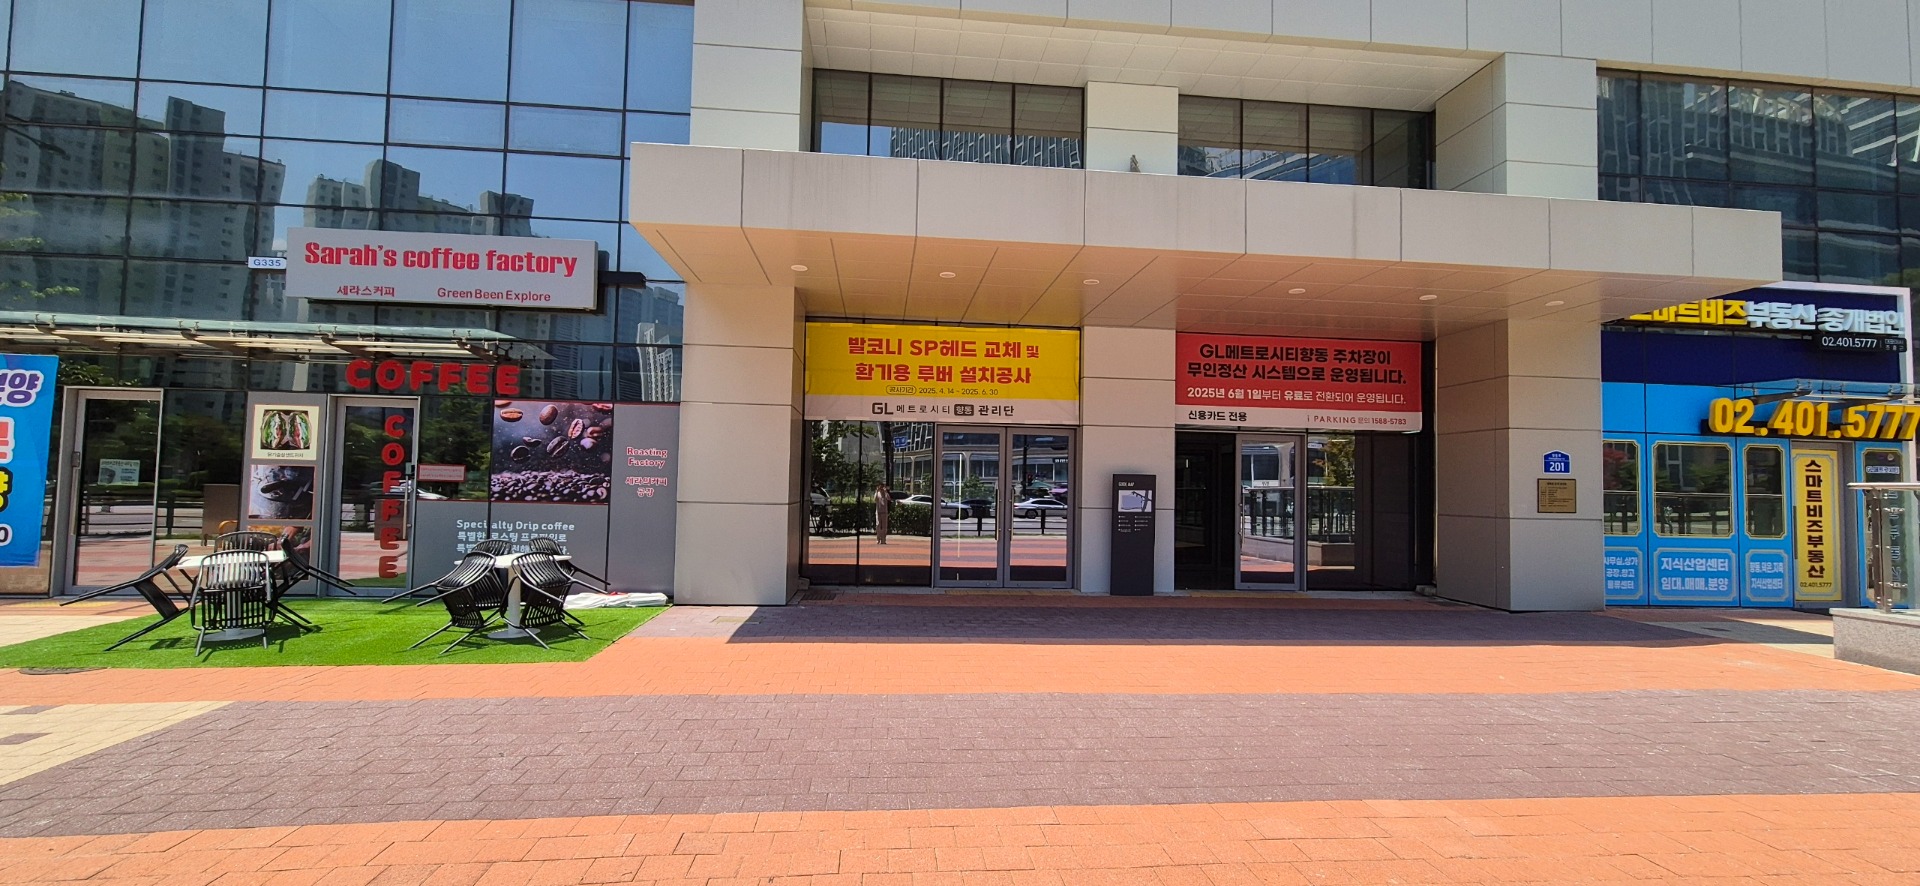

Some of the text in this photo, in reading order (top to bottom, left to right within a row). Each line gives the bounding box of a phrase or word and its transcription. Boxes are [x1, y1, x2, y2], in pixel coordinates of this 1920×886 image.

[253, 258, 282, 267] G335
[403, 247, 480, 271] coffee
[486, 250, 578, 278] factory
[337, 285, 395, 297] 세라스커피
[437, 287, 551, 303] Green Been Explore
[848, 337, 1039, 358] 발코니 SP헤드 교체 및
[1821, 336, 1878, 349] 02.401.5777
[1199, 344, 1390, 365] GL메트로시티향동 주차장이
[345, 359, 521, 395] COFFEE
[855, 363, 1031, 384] 환기용 루버 설치공사
[1187, 362, 1407, 384] 무인정산 시스템으로 운영됩니다.
[889, 386, 914, 394] 공사기간
[1187, 387, 1407, 404] 2025년 6월 1일부터 유료로 전환되어 운영됩니다.
[871, 402, 894, 415] GL
[978, 405, 1014, 416] 관리단
[1188, 410, 1247, 422] 신용카드 전용
[1314, 416, 1356, 424] PARKING
[627, 447, 667, 458] Roasting
[628, 457, 665, 469] Factory
[1549, 462, 1565, 472] 201
[378, 415, 405, 579] COFFEE
[637, 487, 654, 497] 공장
[515, 521, 539, 530] Drip
[541, 522, 575, 531] coffee
[1805, 460, 1825, 578] 스마트비즈부동산
[457, 531, 487, 541] 특별한
[1660, 557, 1729, 572] 지식산업센터
[1660, 577, 1729, 591] 임대.매매.분양
